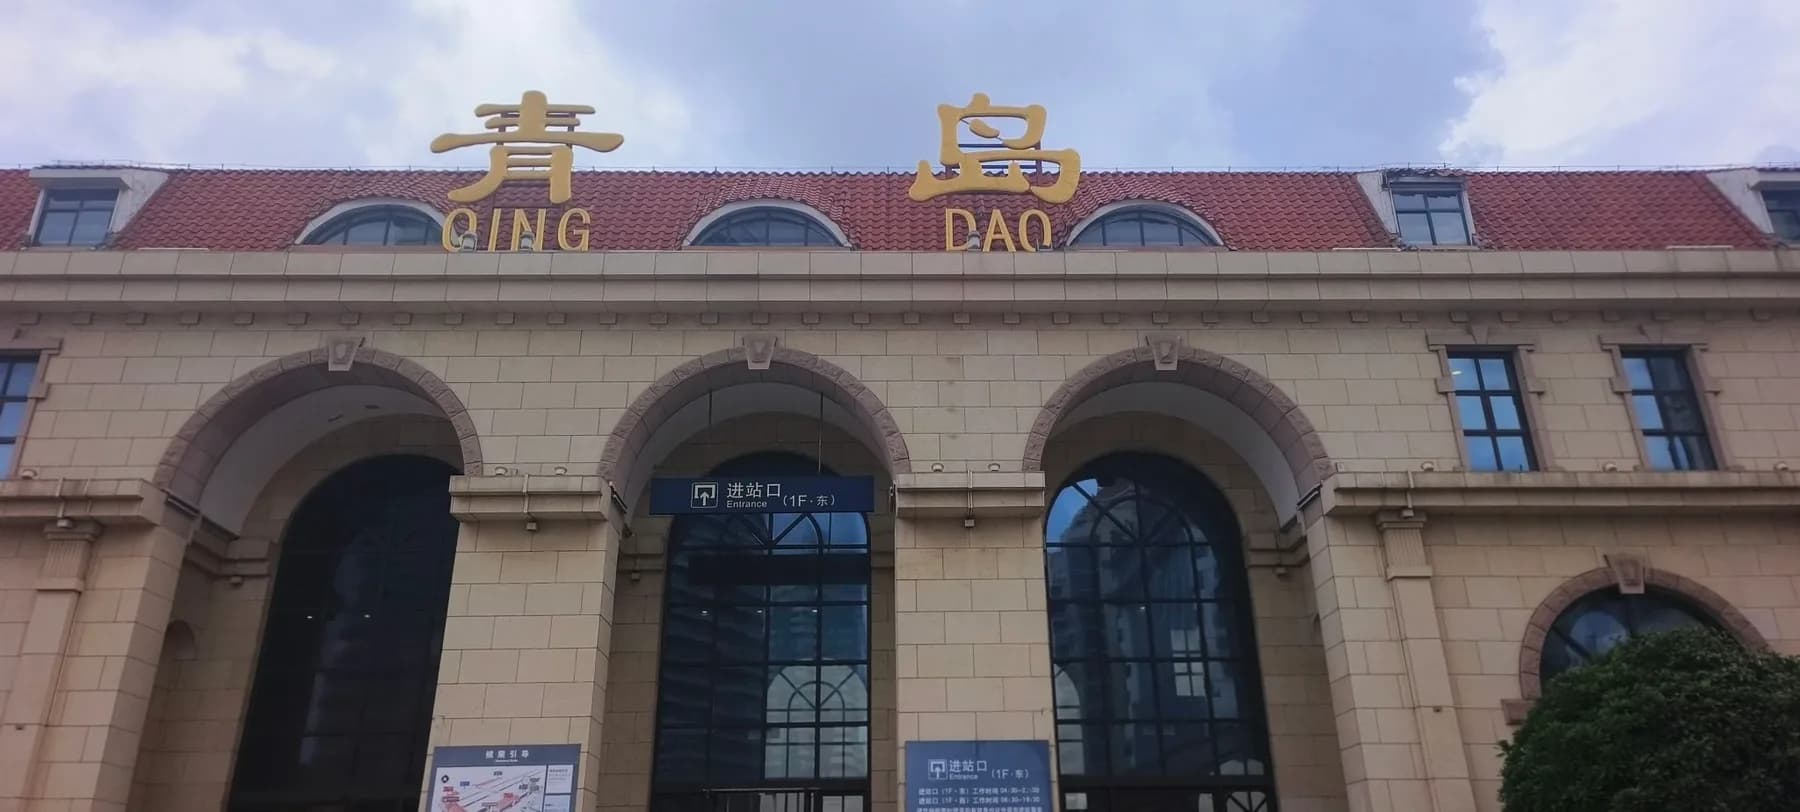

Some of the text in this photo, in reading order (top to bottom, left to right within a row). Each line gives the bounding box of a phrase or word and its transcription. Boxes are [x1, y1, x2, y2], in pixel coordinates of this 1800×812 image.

[442, 207, 1052, 252] QING DAO
[726, 482, 781, 499] 进站口
[726, 500, 768, 509] Entrance
[949, 760, 988, 772] 进站口
